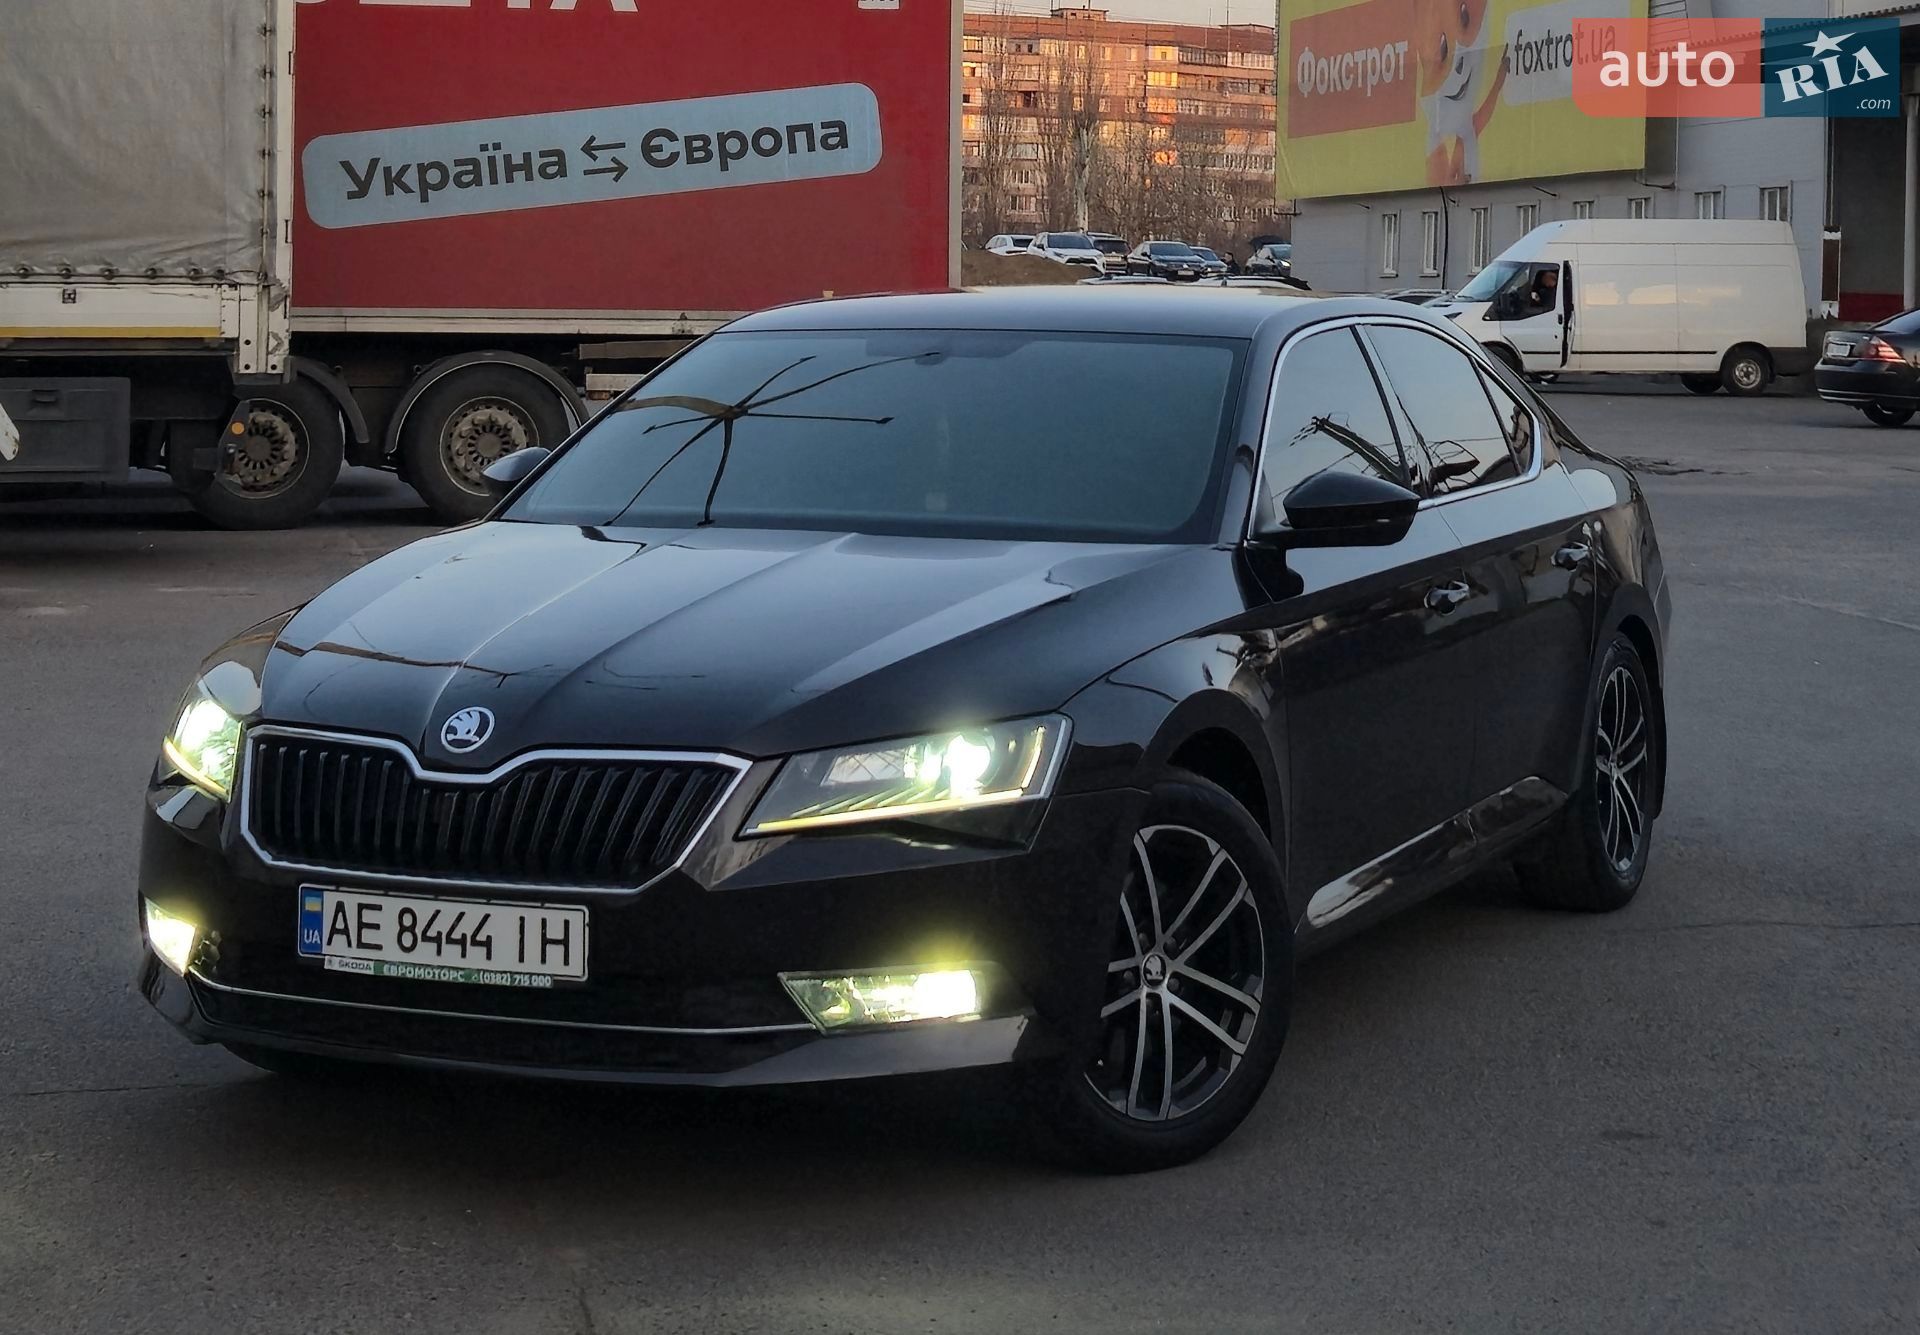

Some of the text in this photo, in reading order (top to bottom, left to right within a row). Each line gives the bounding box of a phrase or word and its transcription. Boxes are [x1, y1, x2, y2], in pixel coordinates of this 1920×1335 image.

[1298, 40, 1408, 98] Фокстрот
[1514, 24, 1616, 75] foxtrot.ua
[339, 119, 849, 203] Україна Європа
[304, 927, 321, 945] UA
[326, 900, 570, 966] AE 8444 IH
